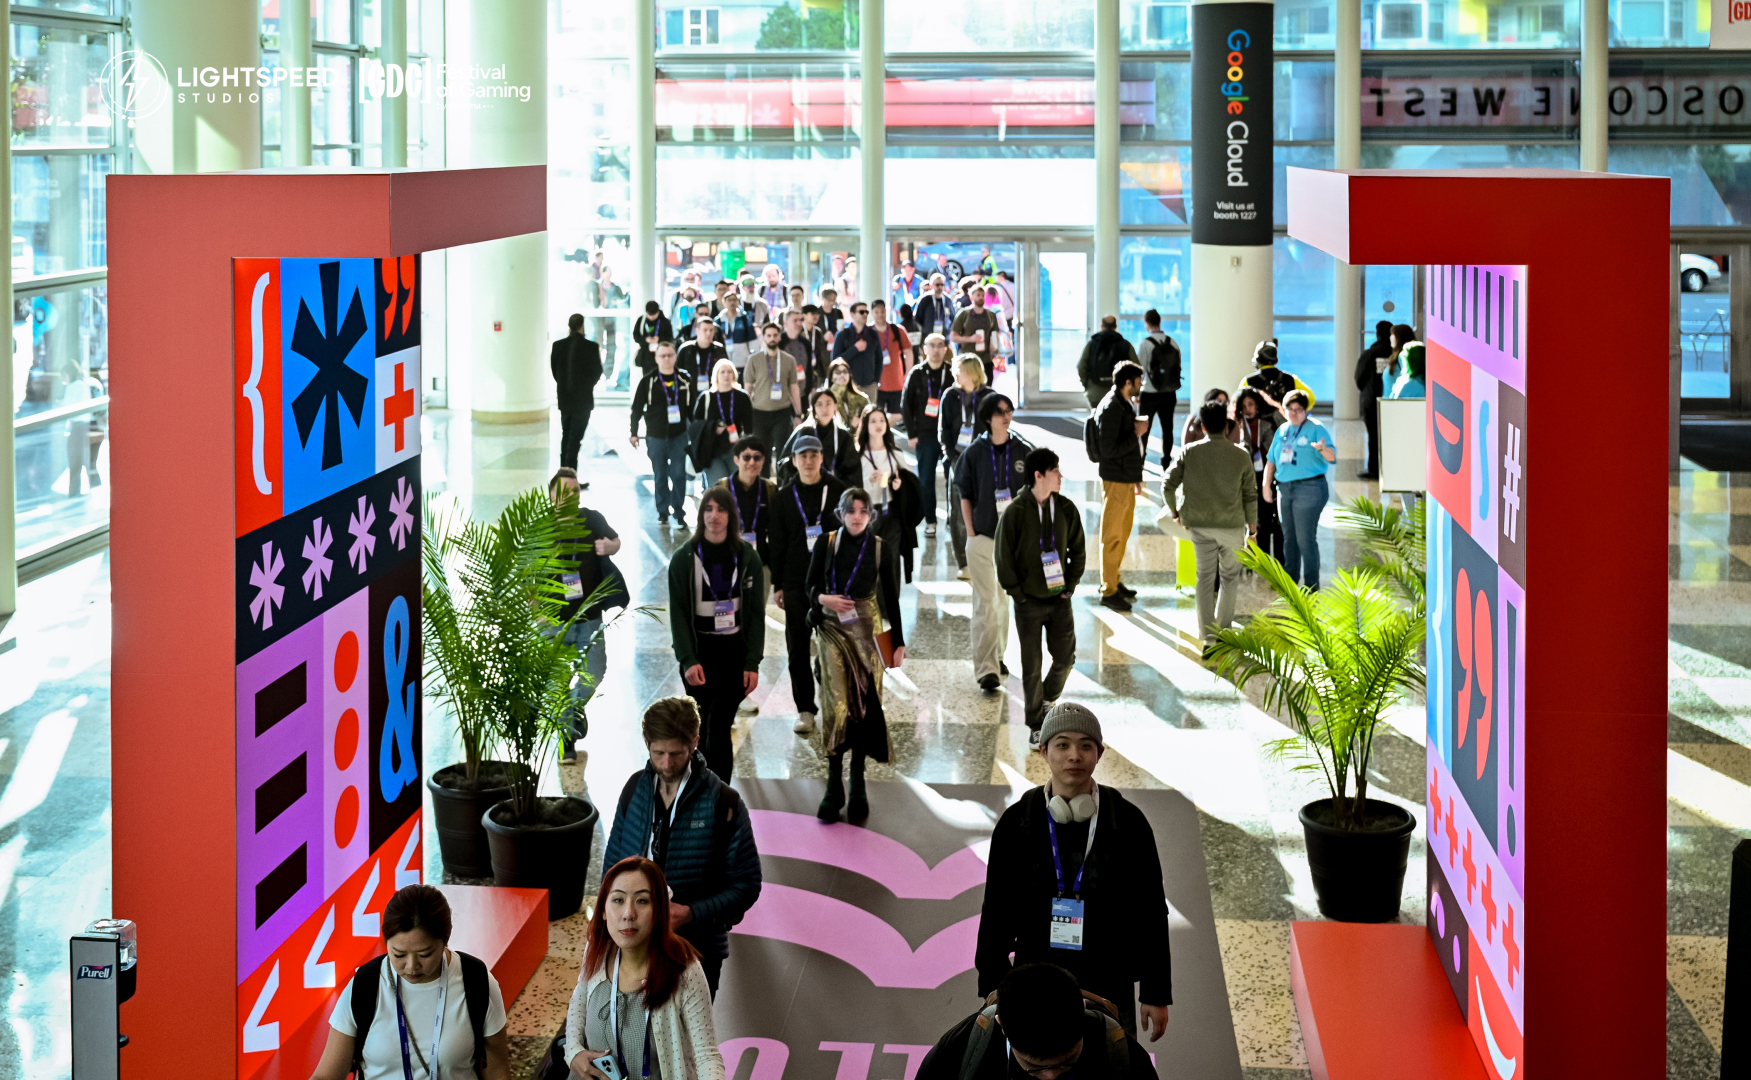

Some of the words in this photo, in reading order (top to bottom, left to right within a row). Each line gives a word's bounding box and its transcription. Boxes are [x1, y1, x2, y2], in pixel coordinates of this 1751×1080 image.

[1221, 29, 1250, 115] Google
[1227, 121, 1249, 186] Cloud
[1216, 201, 1234, 210] Visit
[1246, 202, 1255, 210] at
[1213, 210, 1239, 219] booth
[1240, 211, 1257, 220] 1227
[81, 966, 110, 978] Purell
